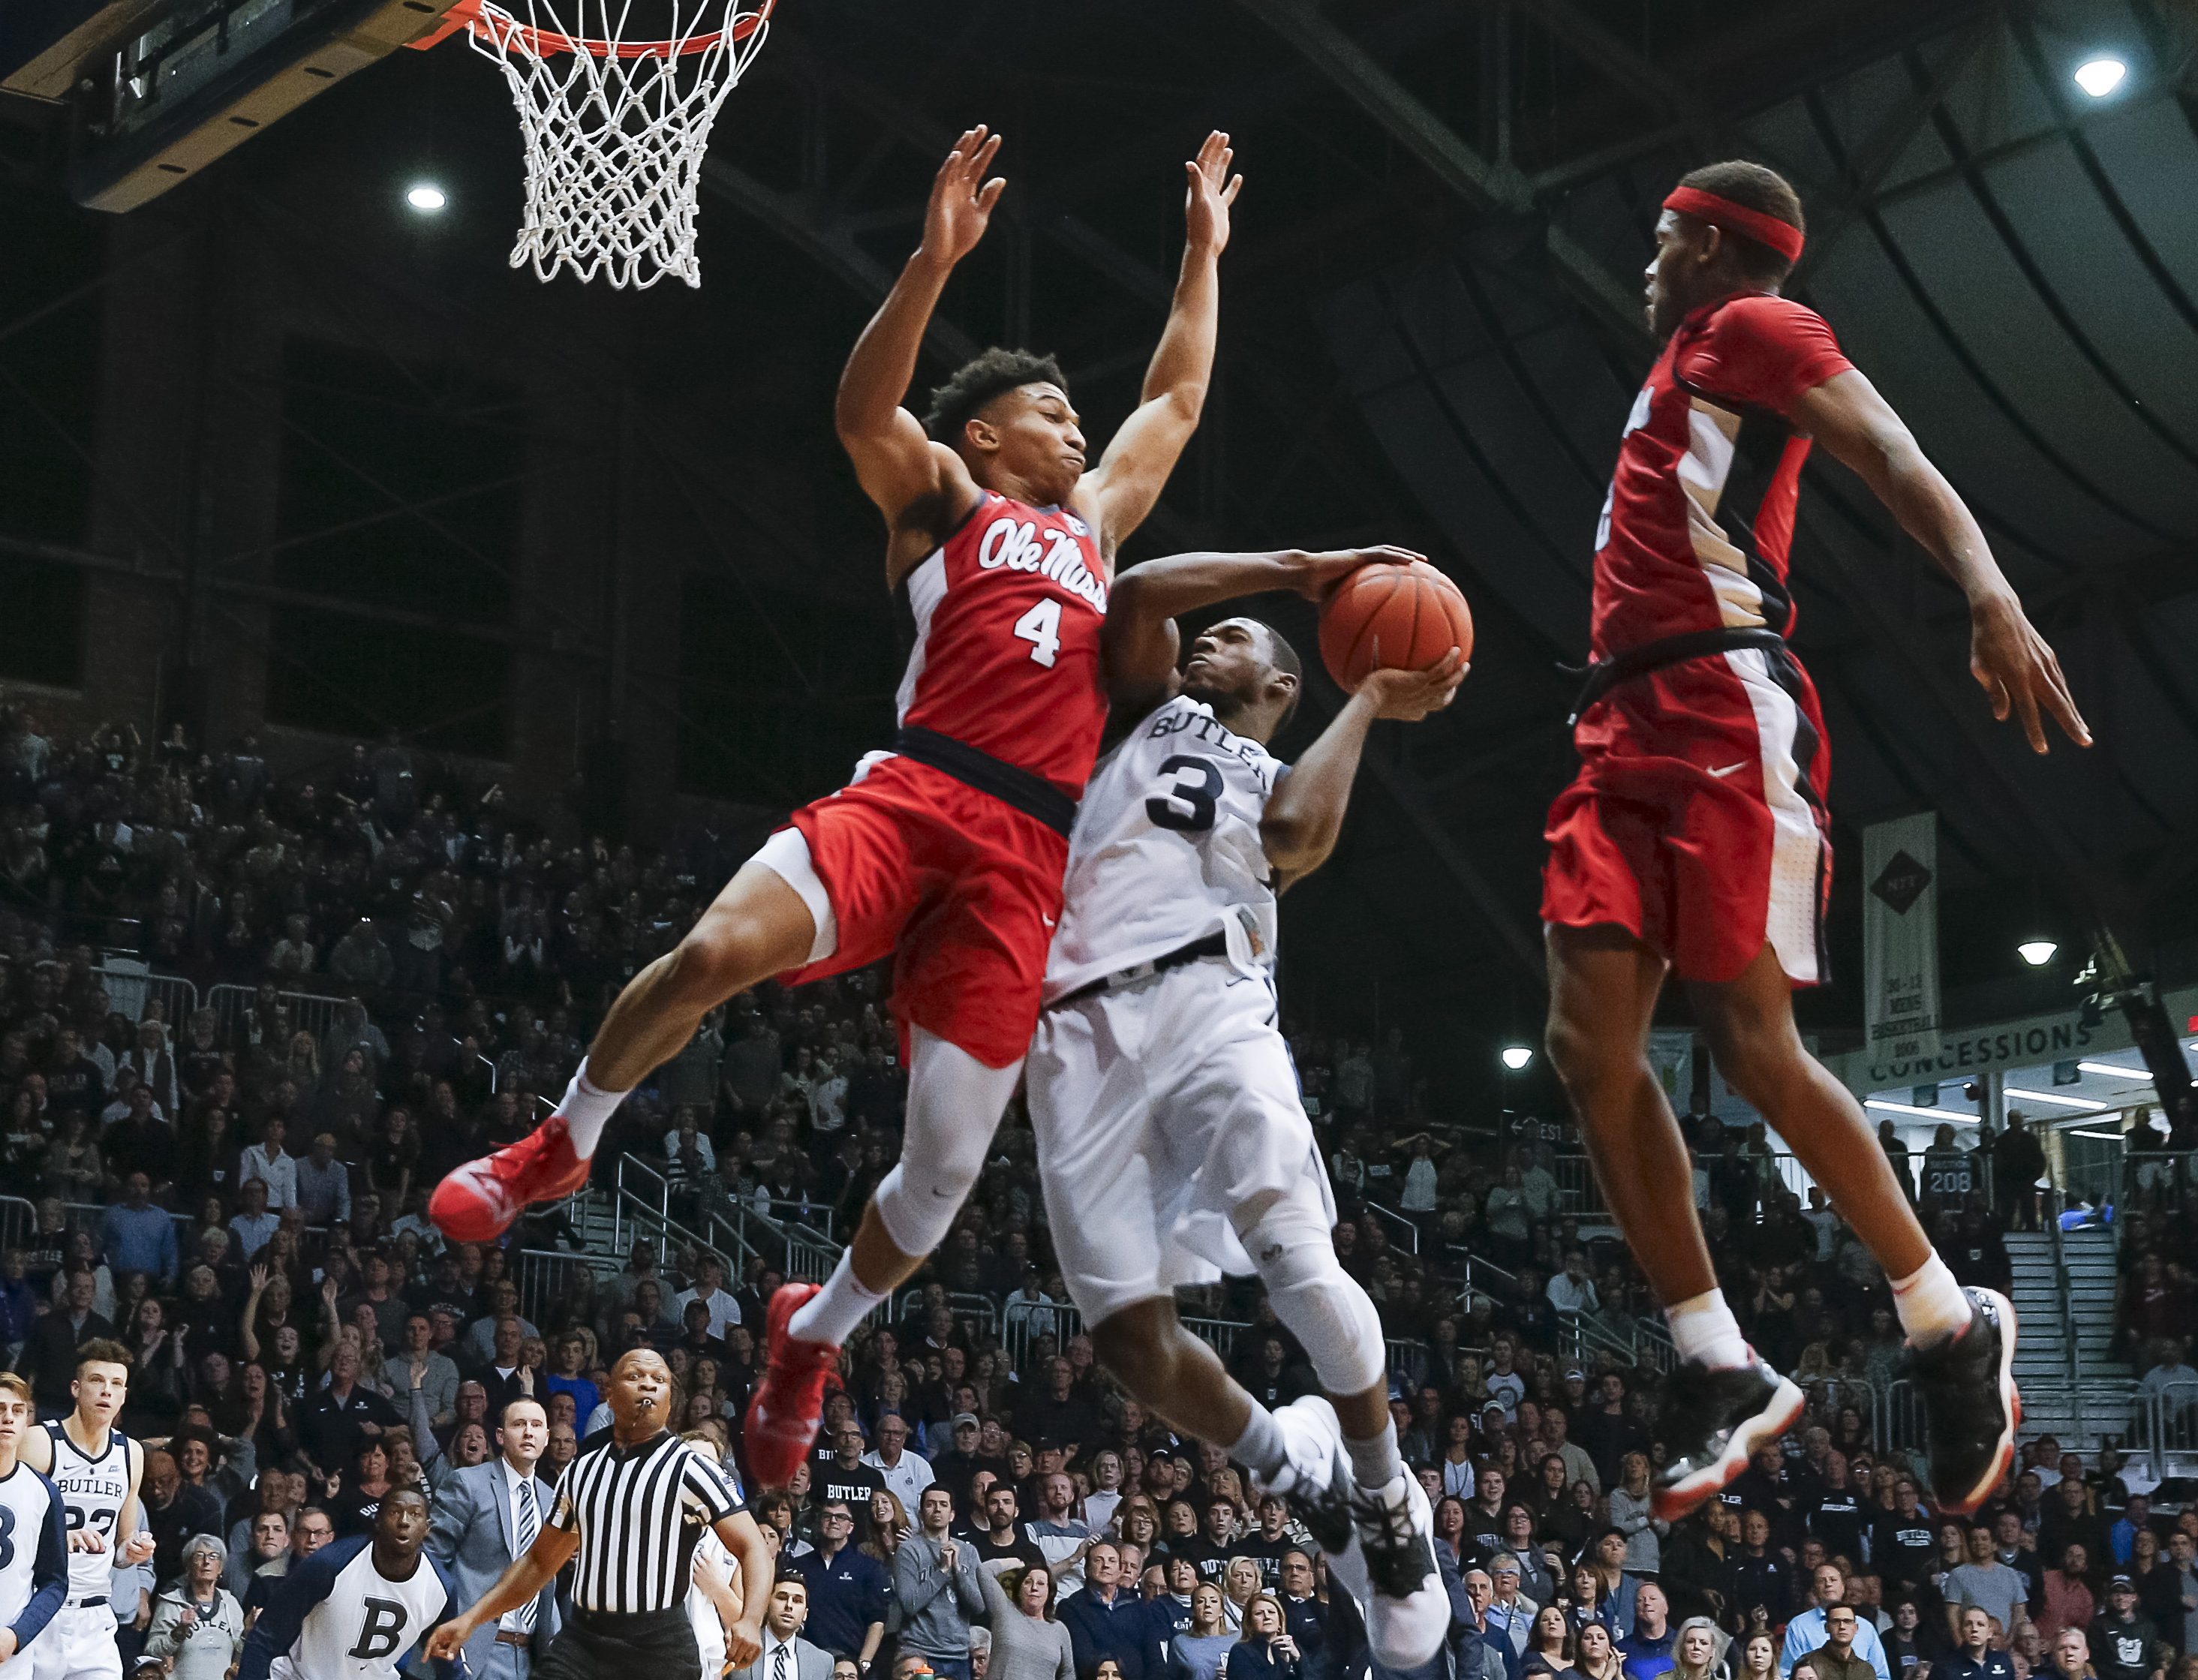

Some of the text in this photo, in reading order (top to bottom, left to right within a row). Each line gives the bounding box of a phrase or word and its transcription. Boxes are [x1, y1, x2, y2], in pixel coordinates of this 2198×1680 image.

[979, 518, 1108, 615] Ole Miss
[1014, 597, 1063, 669] 4
[1145, 755, 1224, 831] 3
[1870, 1020, 2091, 1081] CONCESSIONS
[1929, 1171, 1972, 1193] 208
[59, 1479, 122, 1498] BUTLER
[827, 1483, 871, 1501] BUTLER
[345, 1594, 409, 1660] B
